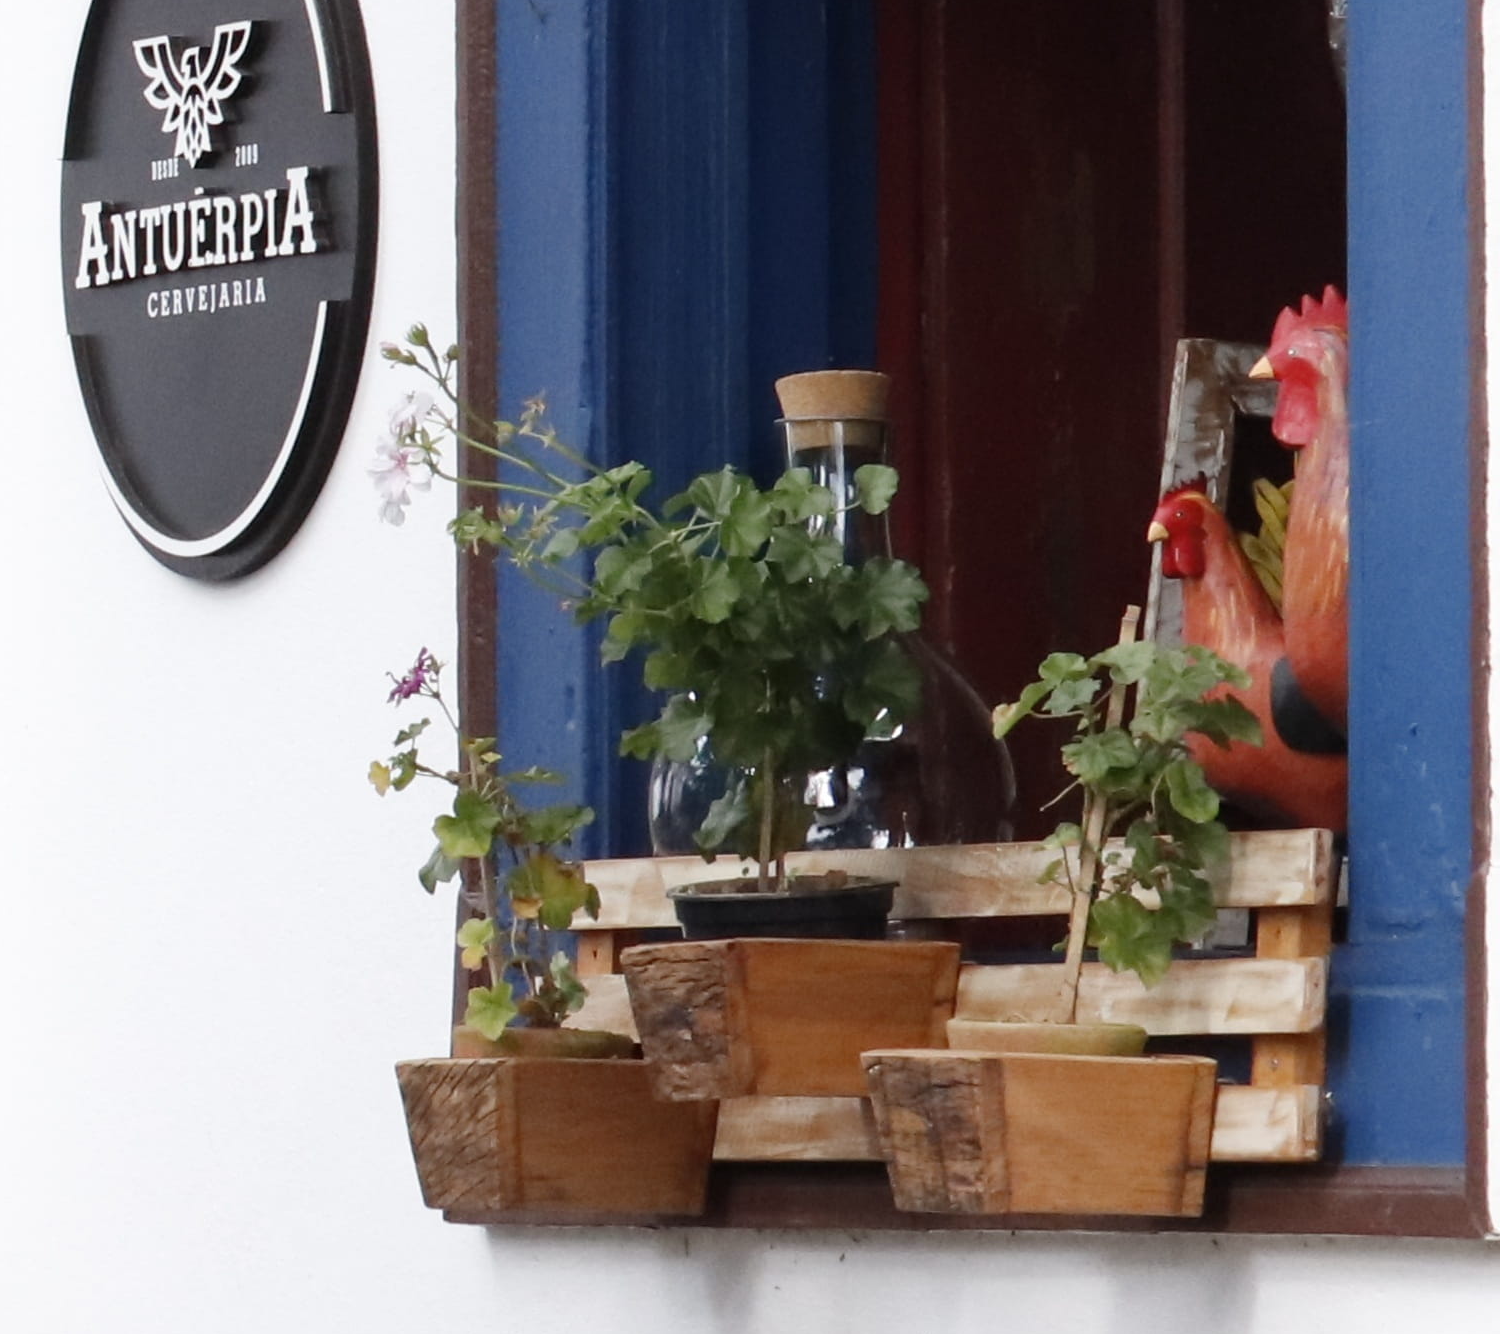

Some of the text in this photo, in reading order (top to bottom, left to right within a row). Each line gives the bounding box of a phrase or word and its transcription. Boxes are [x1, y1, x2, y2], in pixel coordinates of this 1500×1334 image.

[151, 143, 259, 182] DESDE 2009
[74, 166, 318, 290] ANTUÉRPIA
[146, 277, 267, 318] CERVEJARIA
